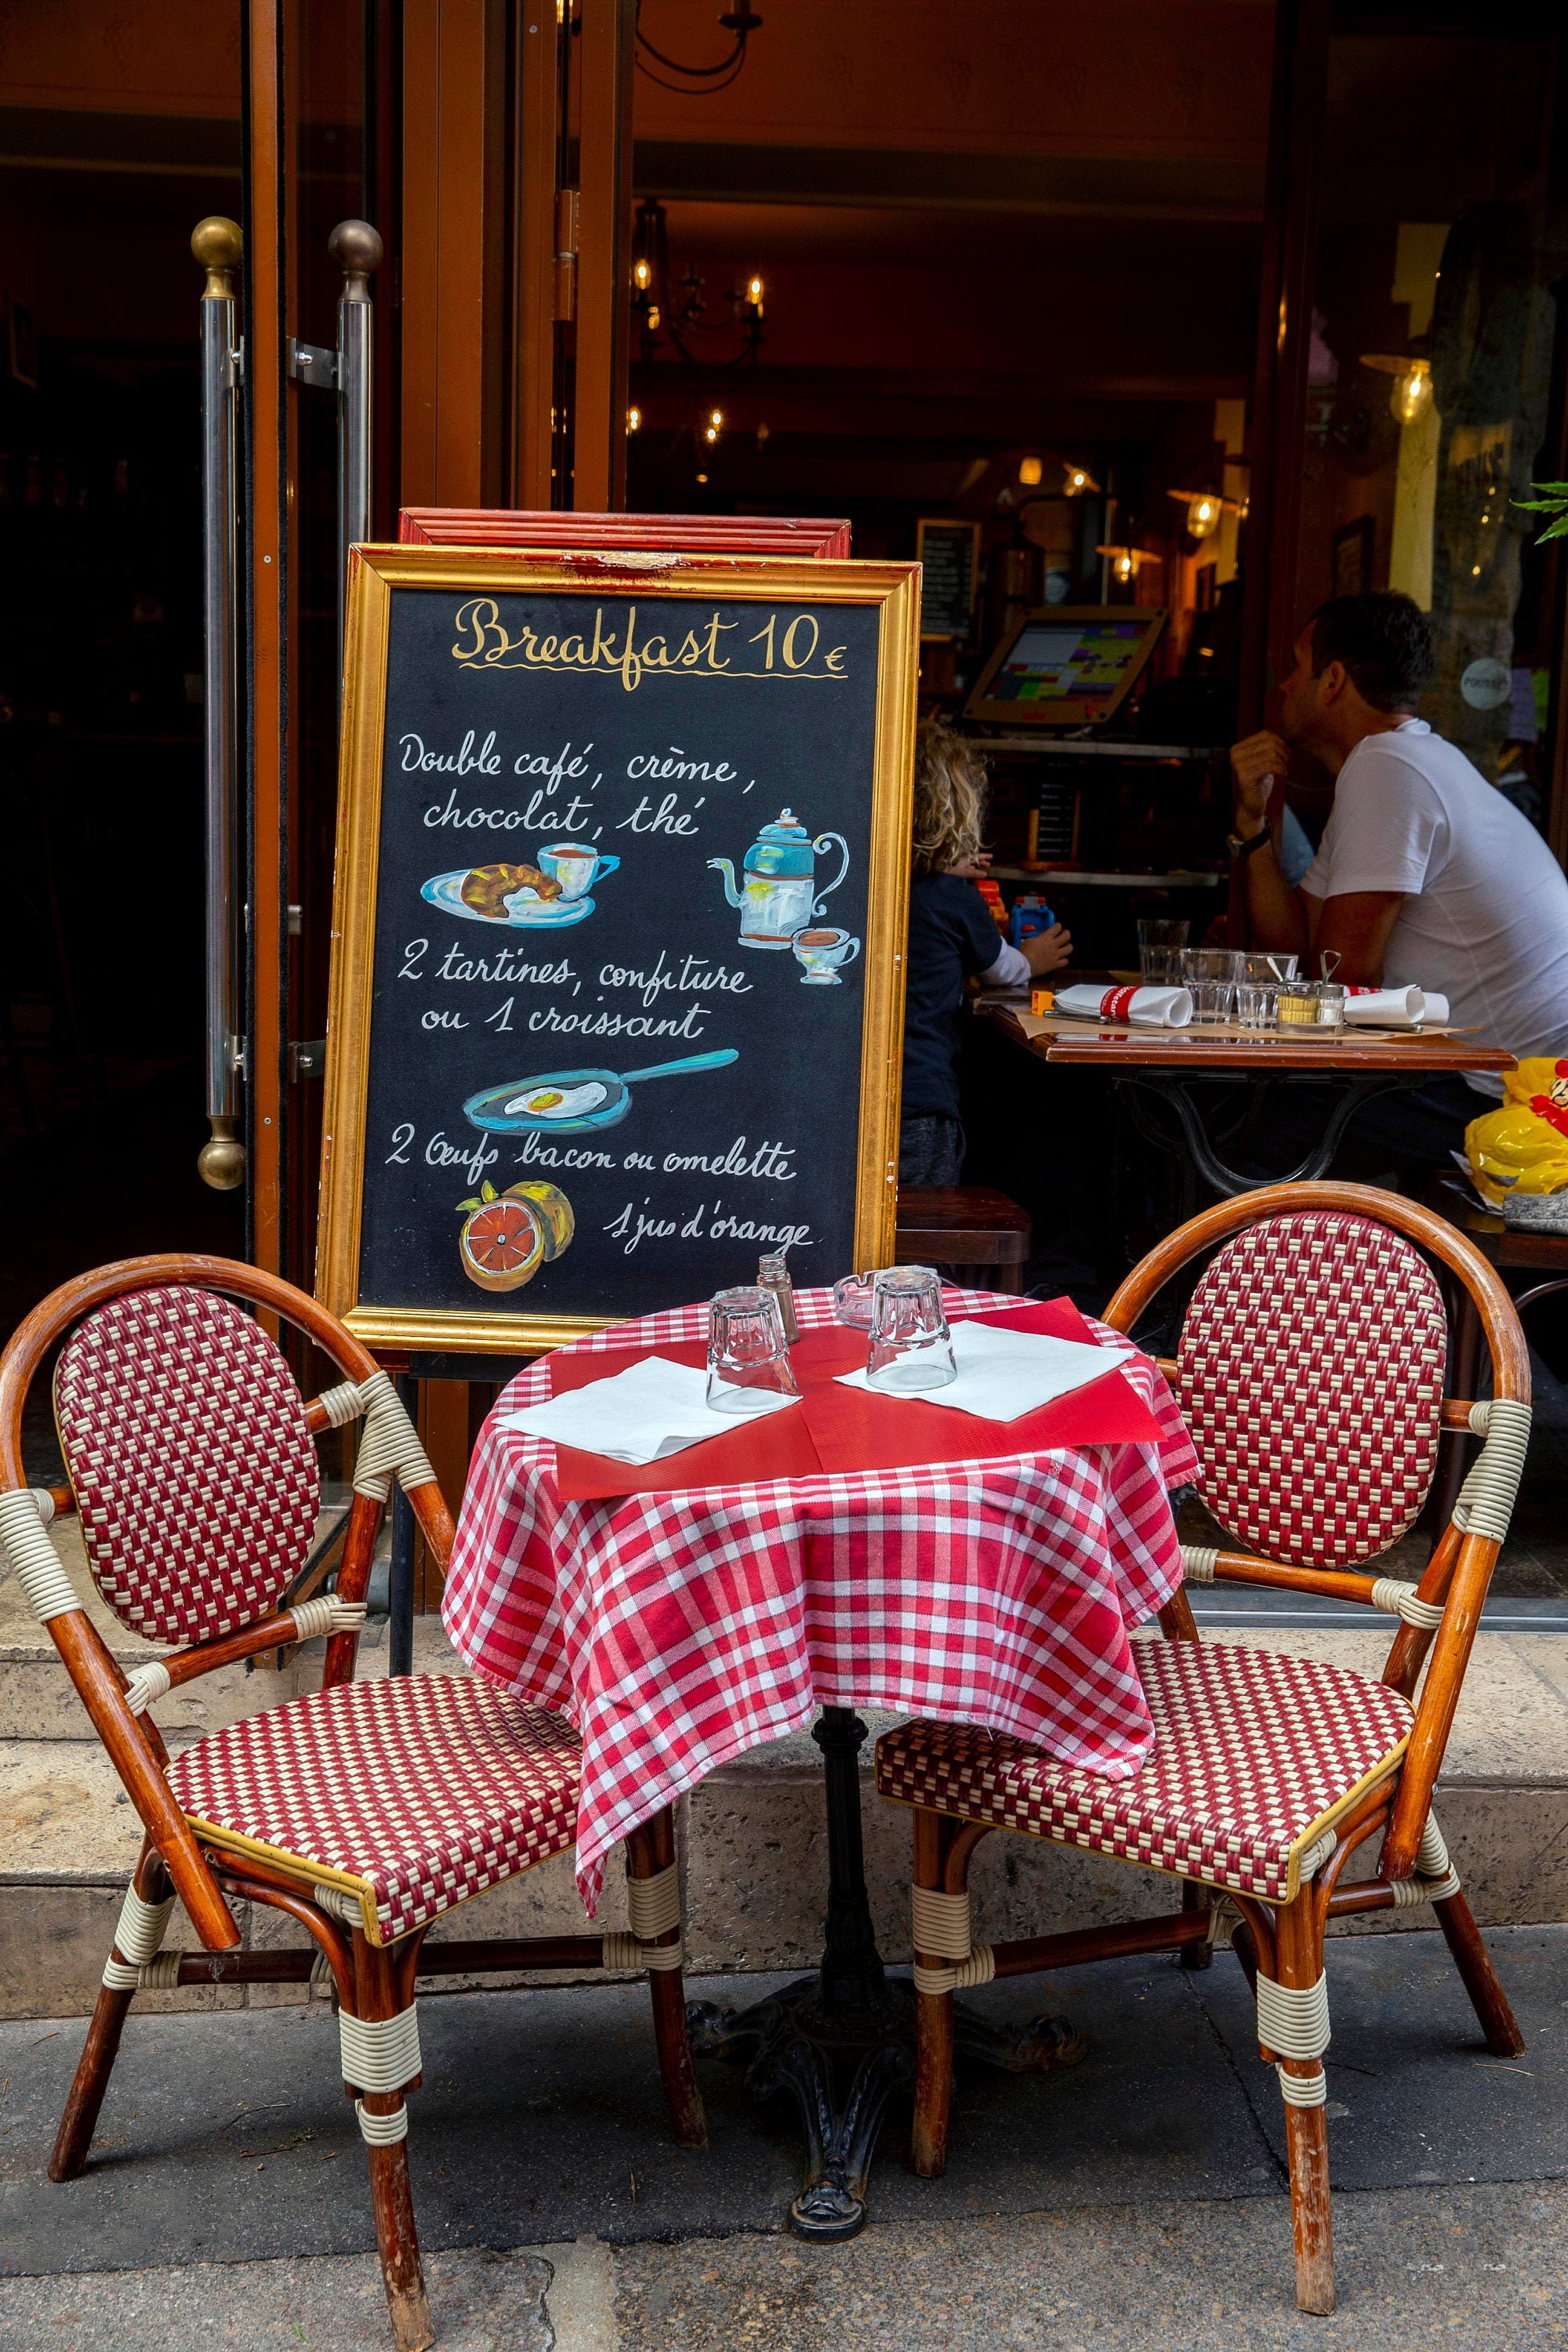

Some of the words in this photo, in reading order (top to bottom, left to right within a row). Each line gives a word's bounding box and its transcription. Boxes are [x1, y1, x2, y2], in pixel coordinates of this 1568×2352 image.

[452, 597, 739, 691] Breakfast
[399, 730, 502, 775] Double
[514, 742, 603, 795] café,
[423, 789, 603, 840] chocolat,
[615, 793, 706, 836] thé
[397, 938, 429, 980] 2
[434, 941, 582, 996] tartines,
[599, 949, 754, 1007] confiture
[421, 1010, 470, 1029] ou
[484, 997, 515, 1032] 1
[528, 996, 712, 1039] croissant
[384, 1123, 416, 1164] 2
[514, 1131, 617, 1169] bacon
[622, 1152, 656, 1171] ou
[663, 1135, 797, 1181] omelette
[681, 1200, 815, 1255] d'orange
